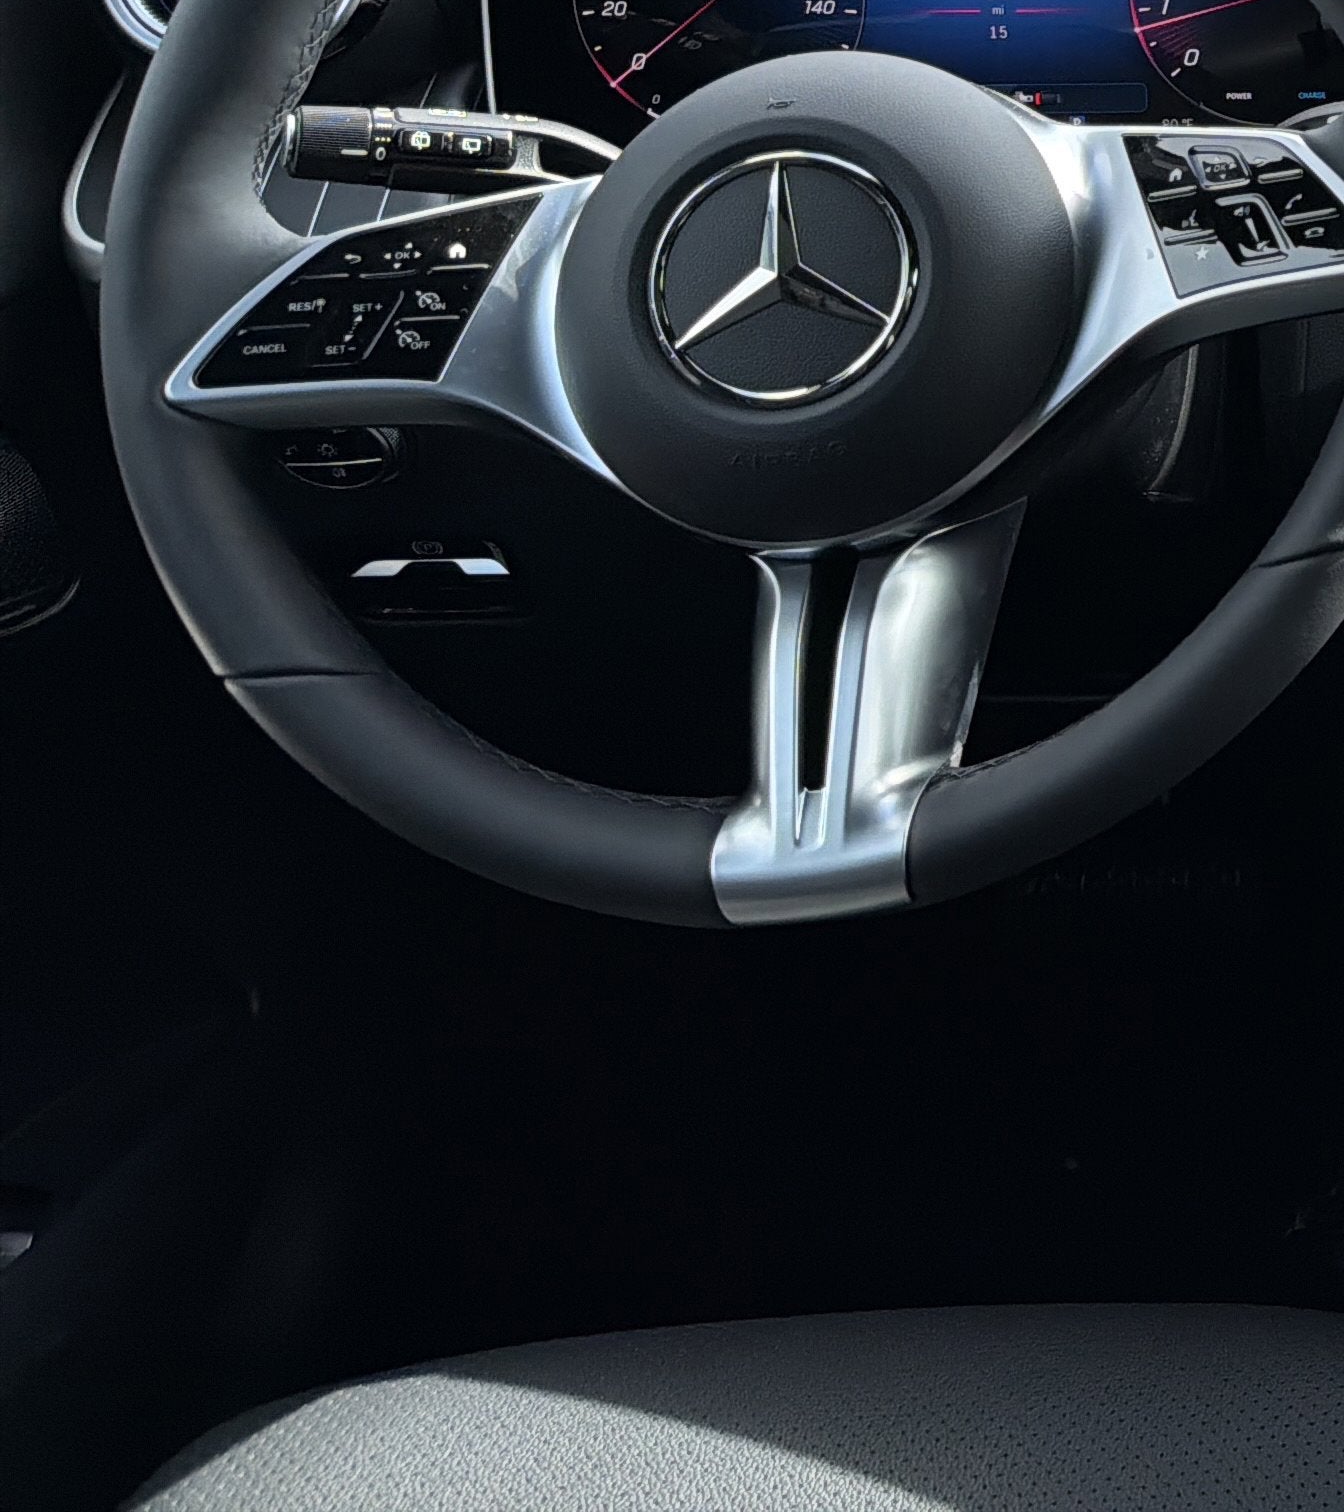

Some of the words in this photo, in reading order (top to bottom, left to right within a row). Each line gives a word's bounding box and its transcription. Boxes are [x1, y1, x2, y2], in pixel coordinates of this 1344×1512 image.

[601, 1, 628, 17] 20
[805, 0, 836, 15] 140
[991, 5, 1005, 16] mi
[989, 25, 1008, 40] 15
[631, 53, 647, 71] 0
[1183, 48, 1199, 67] 0
[652, 94, 661, 104] 0
[1225, 92, 1253, 101] POWER
[394, 251, 411, 260] OK
[430, 301, 447, 311] ON
[242, 343, 287, 355] CANCEL
[410, 341, 431, 350] OFF
